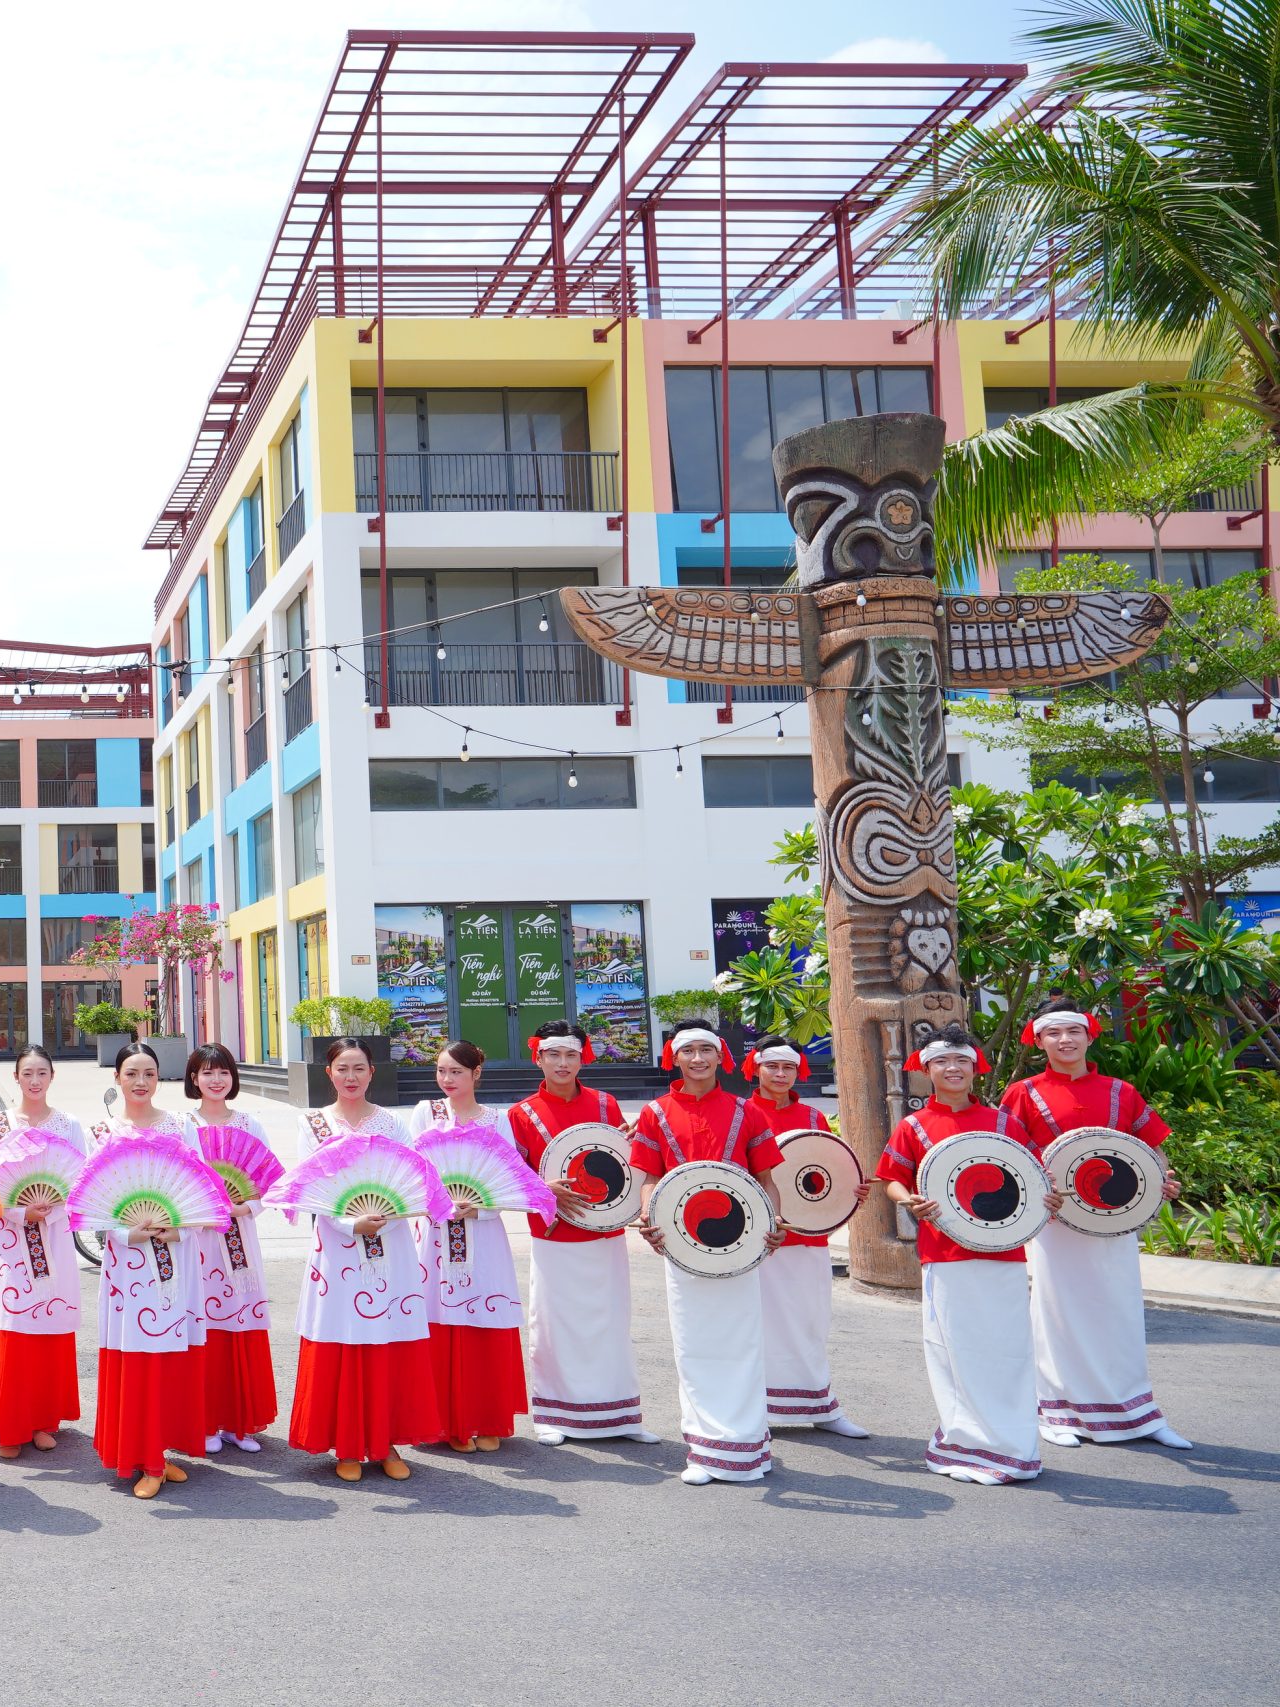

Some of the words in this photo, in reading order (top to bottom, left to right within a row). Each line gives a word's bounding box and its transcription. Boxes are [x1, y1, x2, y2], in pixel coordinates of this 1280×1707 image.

[460, 927, 473, 935] LA
[476, 925, 498, 935] TIÊN
[518, 926, 532, 934] LA
[534, 925, 557, 934] TIÊN
[460, 953, 485, 979] Tiện
[518, 952, 544, 979] Tiện
[389, 977, 405, 986] LA
[407, 976, 435, 986] TIÊN
[476, 963, 503, 989] nghi
[535, 963, 562, 988] nghi
[587, 974, 603, 984] LA
[605, 972, 634, 983] TIÊN
